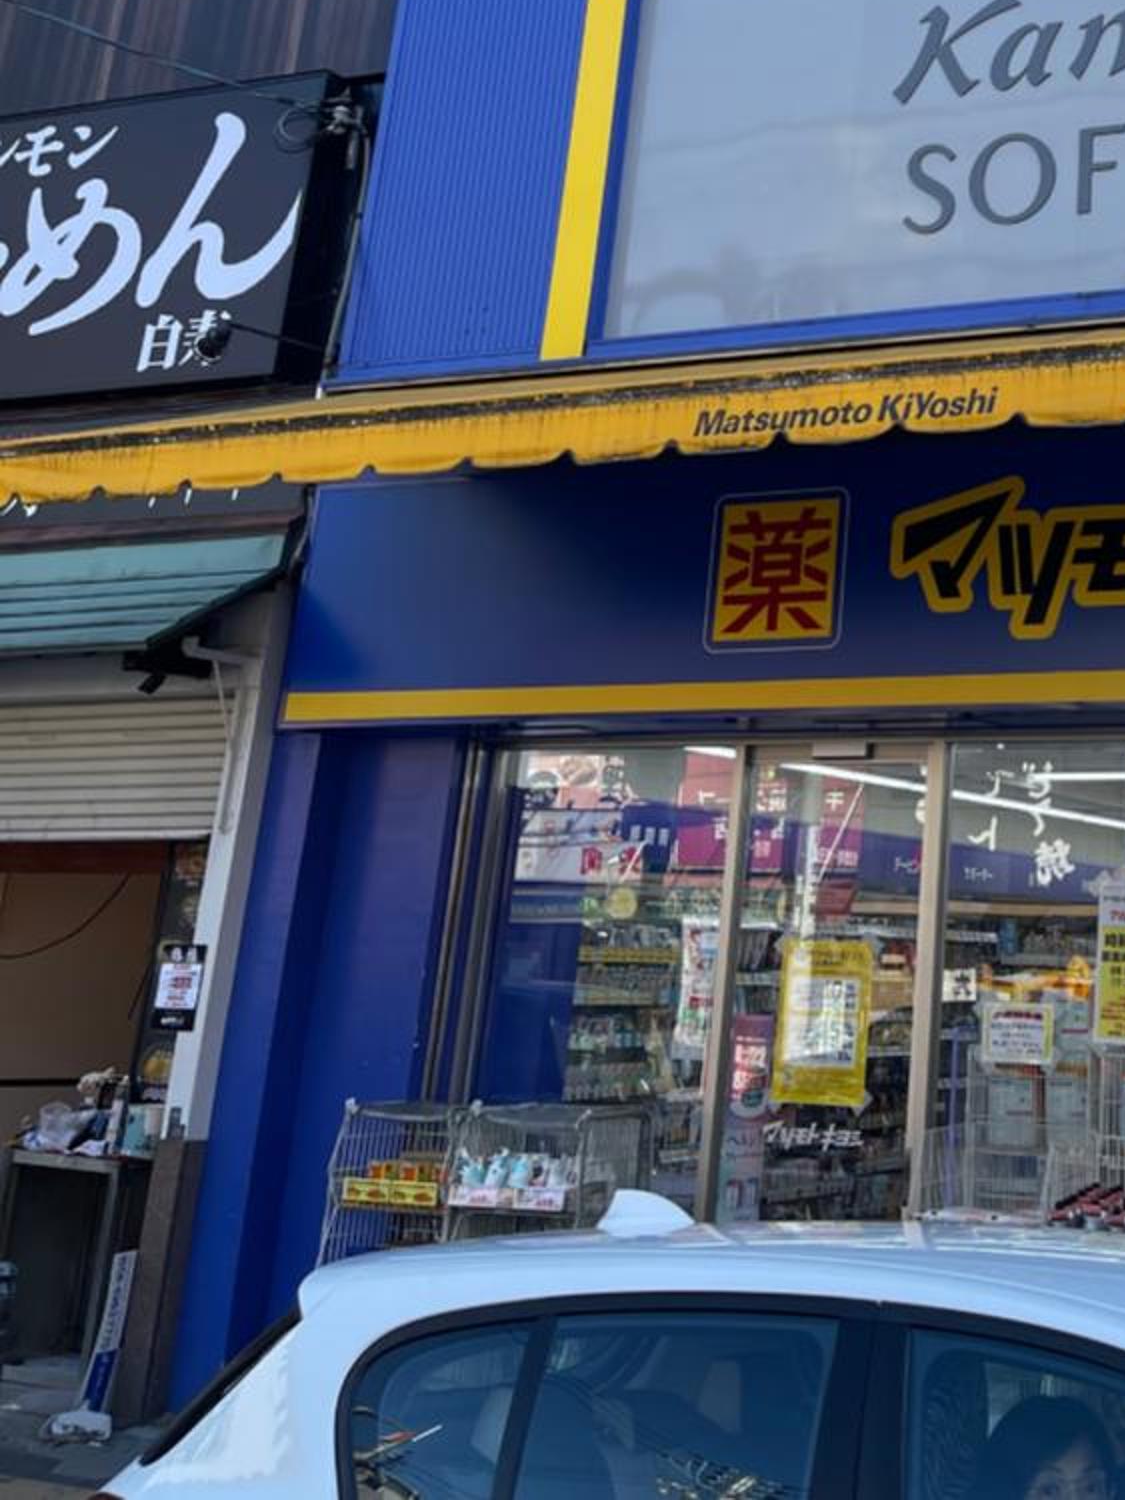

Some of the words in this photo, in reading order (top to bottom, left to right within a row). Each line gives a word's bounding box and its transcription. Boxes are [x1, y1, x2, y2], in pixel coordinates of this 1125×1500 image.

[694, 402, 873, 437] Matsumoto
[877, 386, 999, 422] KiYoshi
[720, 506, 834, 636] 薬
